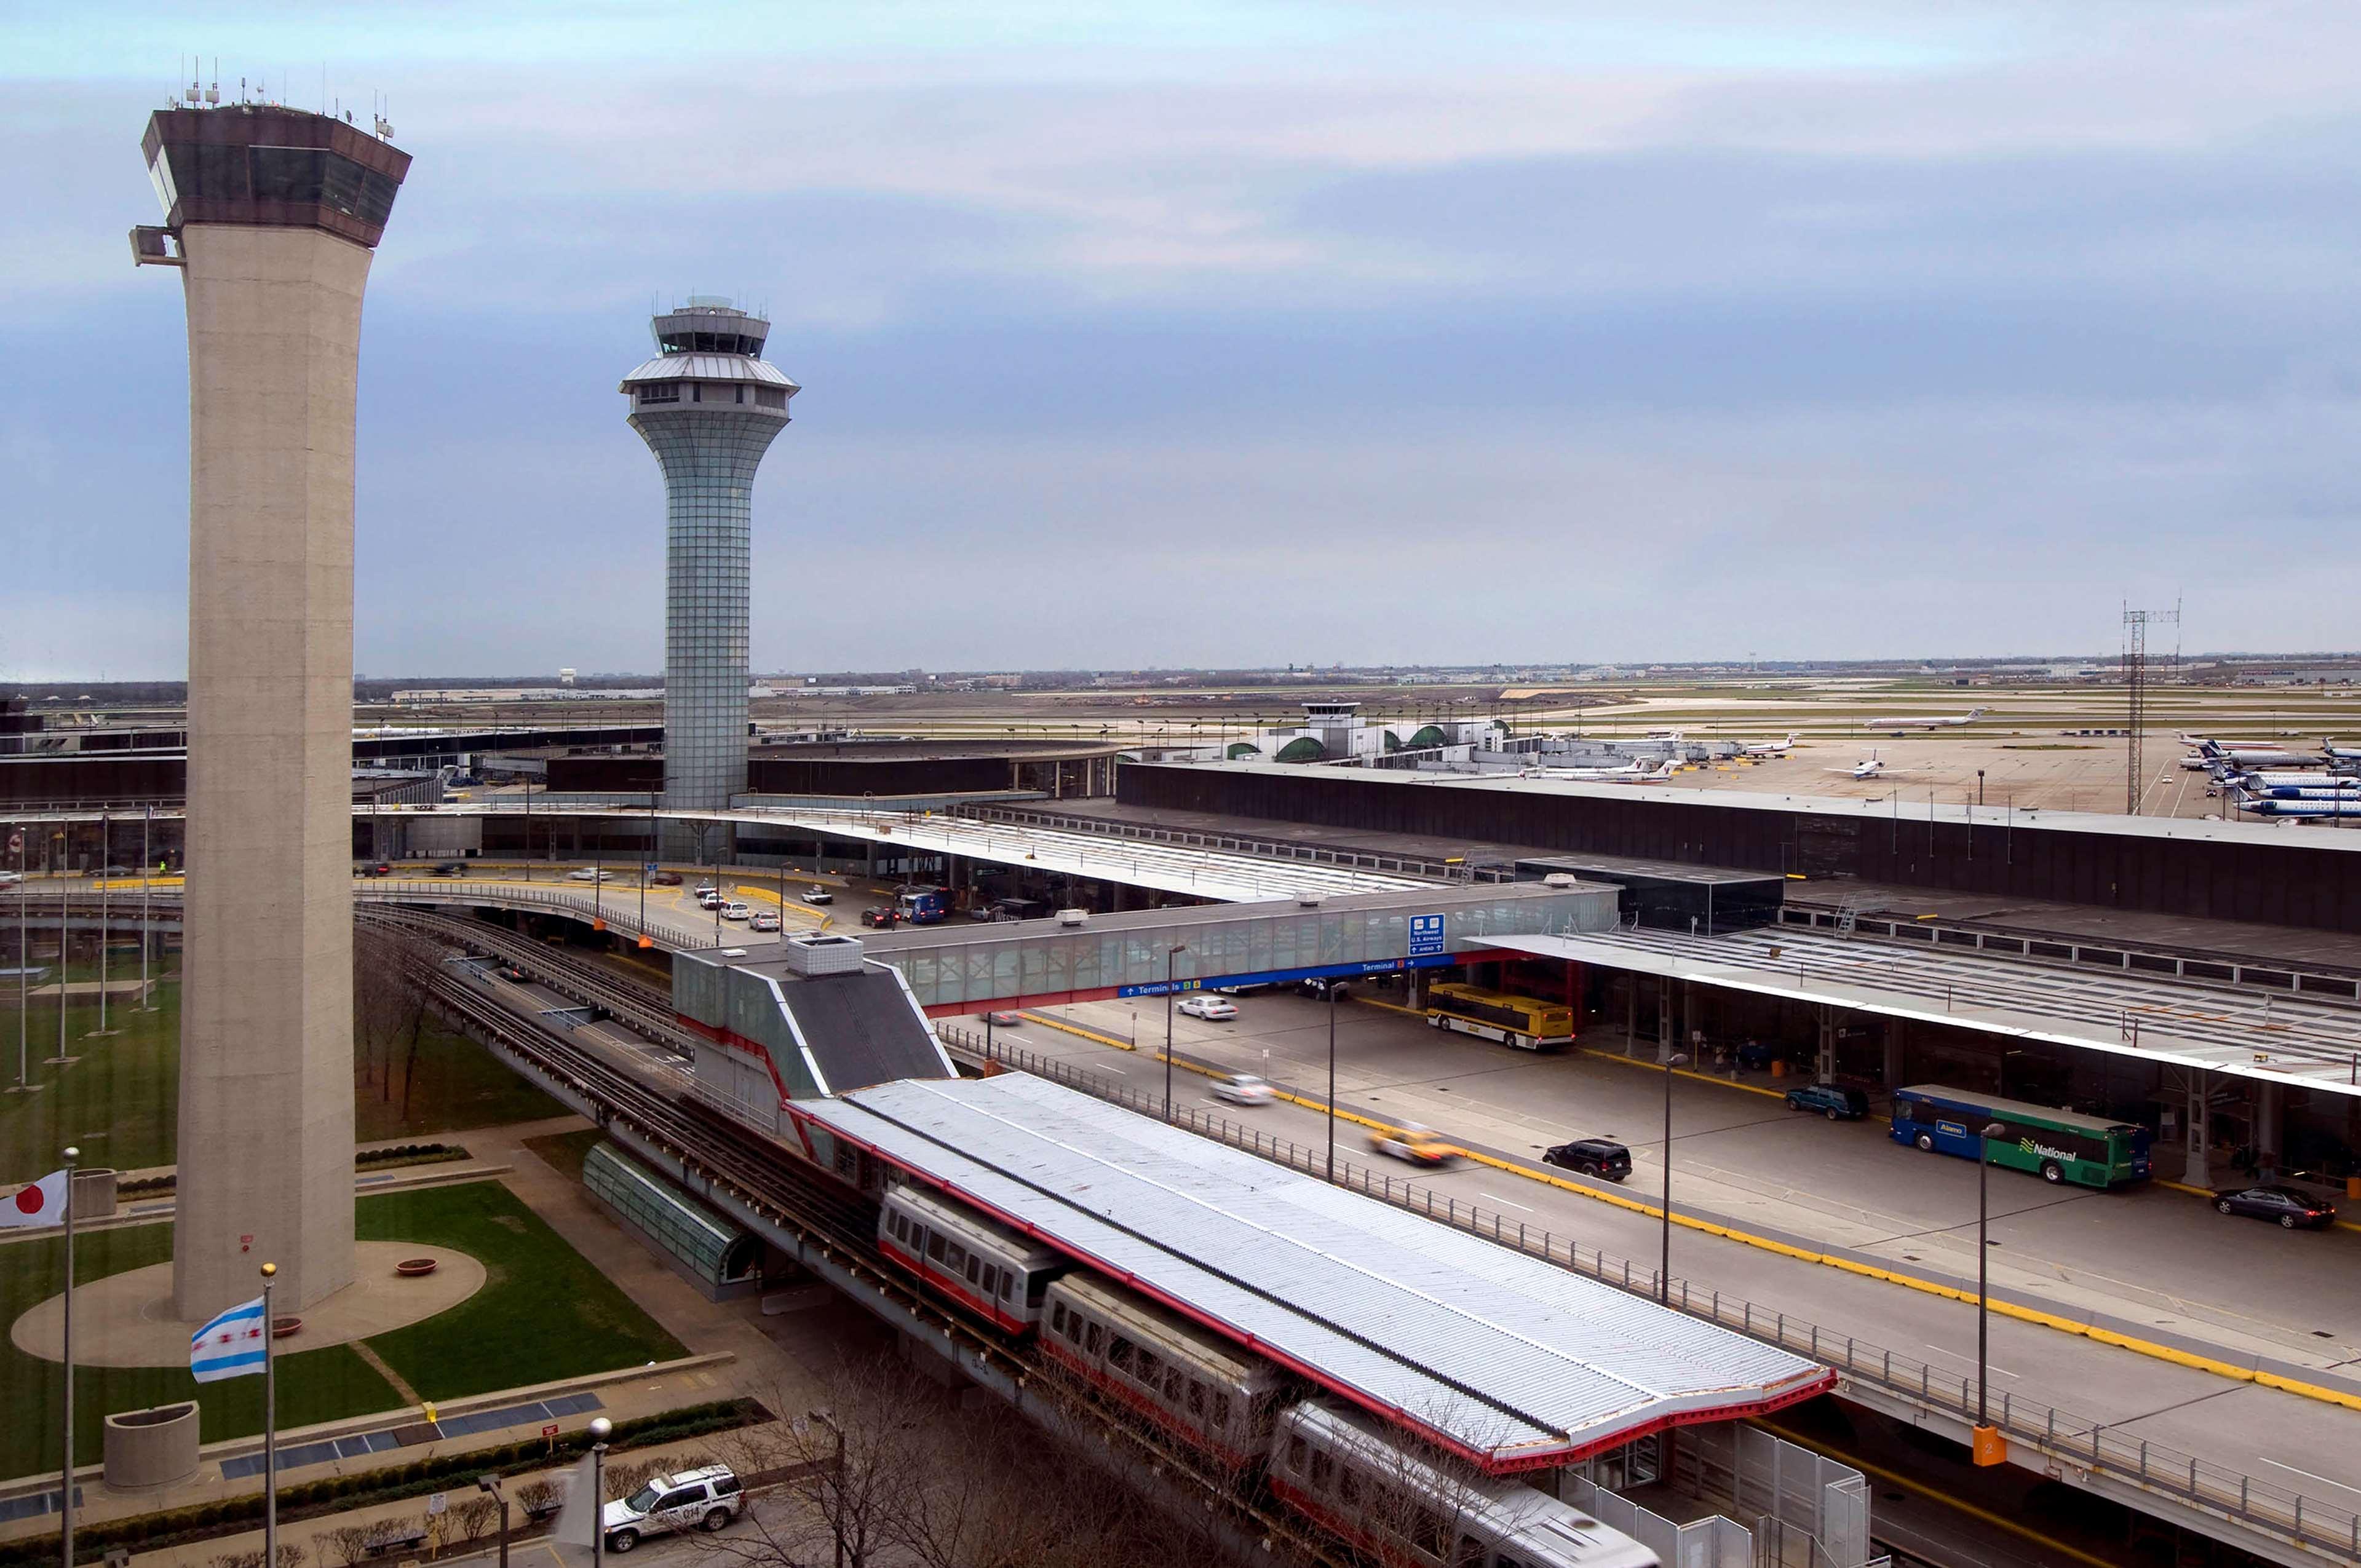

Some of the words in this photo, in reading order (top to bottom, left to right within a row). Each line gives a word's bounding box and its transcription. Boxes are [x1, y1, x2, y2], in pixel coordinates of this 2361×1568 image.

[1362, 962, 1394, 971] Terminal
[1139, 983, 1180, 994] Terminls
[1940, 1123, 1962, 1134] Alamo
[2033, 1143, 2076, 1162] National
